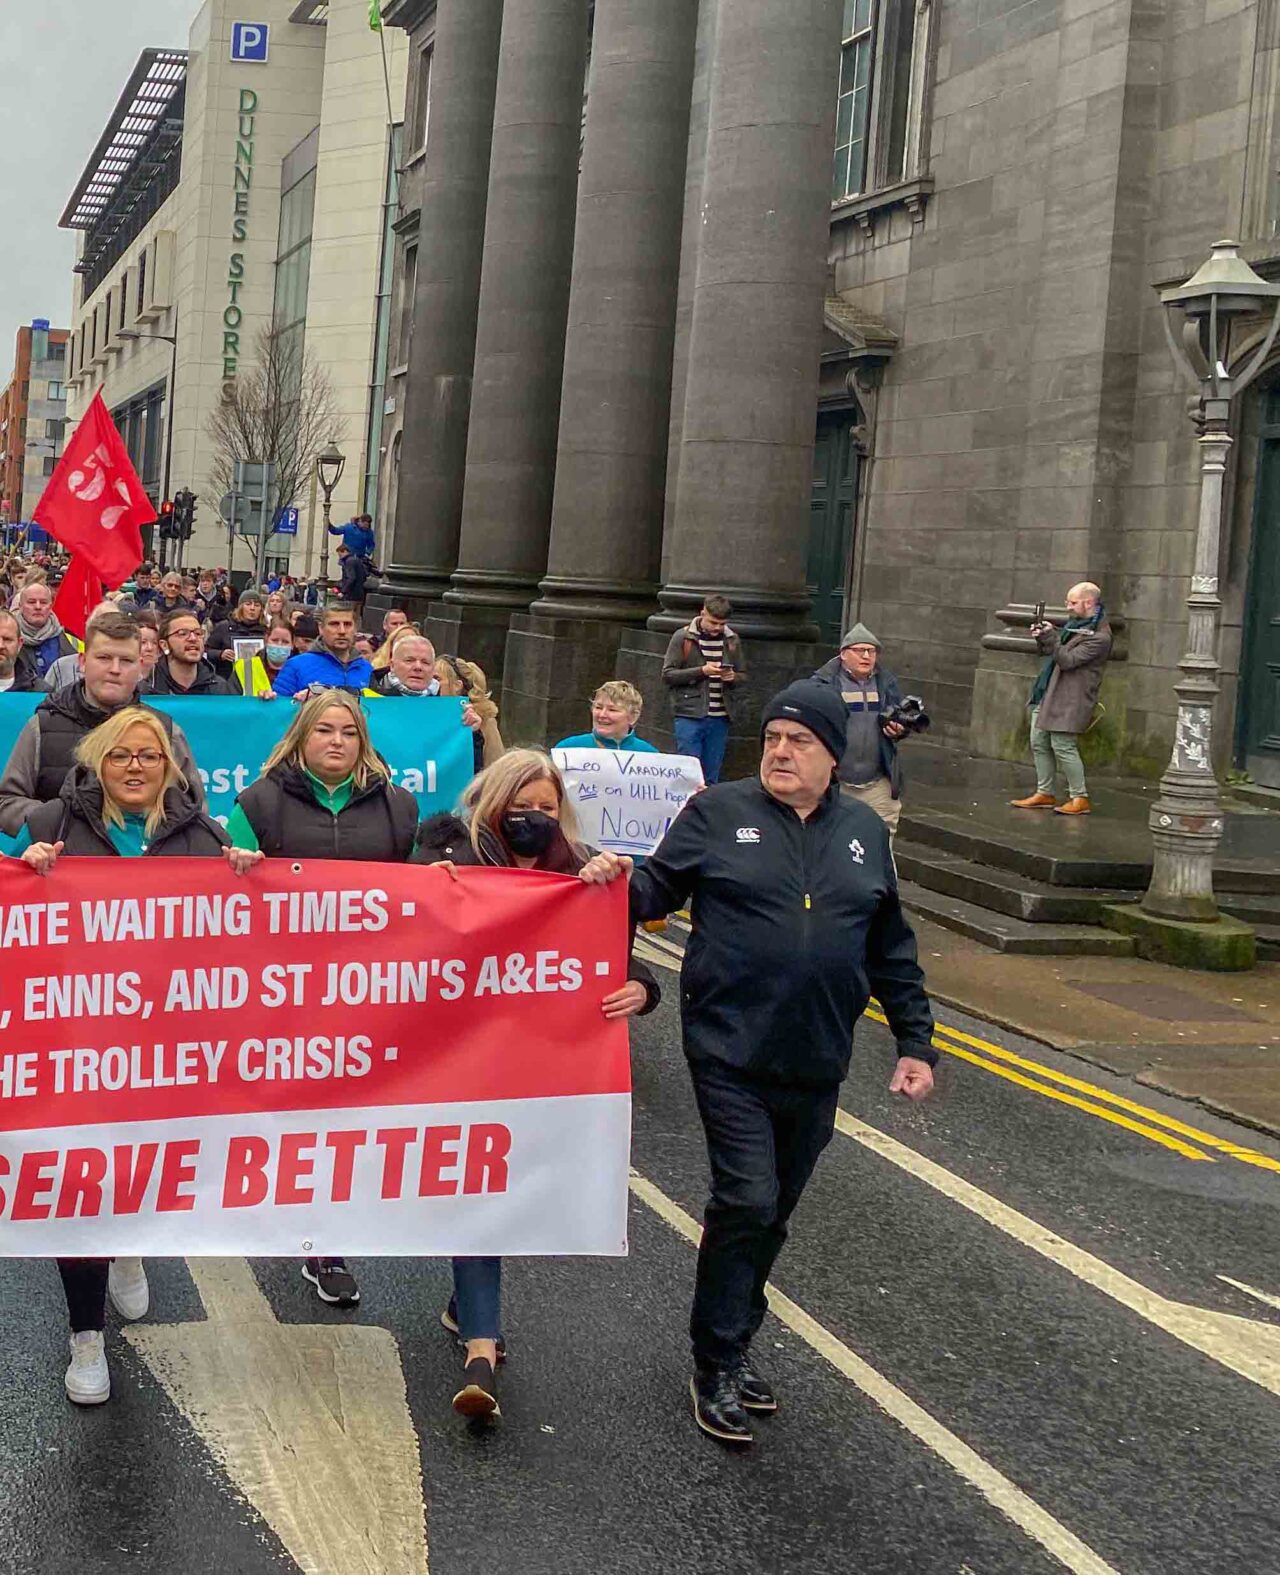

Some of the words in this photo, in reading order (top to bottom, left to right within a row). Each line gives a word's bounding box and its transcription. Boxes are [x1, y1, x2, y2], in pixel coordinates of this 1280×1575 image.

[239, 26, 262, 56] P
[232, 88, 258, 242] DUNNES
[220, 252, 245, 407] STORES
[563, 752, 601, 773] Leo
[578, 783, 598, 795] Act
[604, 786, 622, 796] on
[630, 783, 663, 801] UHL
[81, 894, 250, 943] WAITING
[262, 888, 389, 935] TIMES
[23, 970, 154, 1022] ENNIS,
[164, 966, 249, 1013] AND
[260, 963, 311, 1008] ST
[321, 958, 465, 1007] JOHN'S
[474, 950, 583, 998] A&Es
[49, 1041, 227, 1093] TROLLEY
[238, 1035, 373, 1082] CRISIS
[222, 1122, 512, 1209] BETTER
